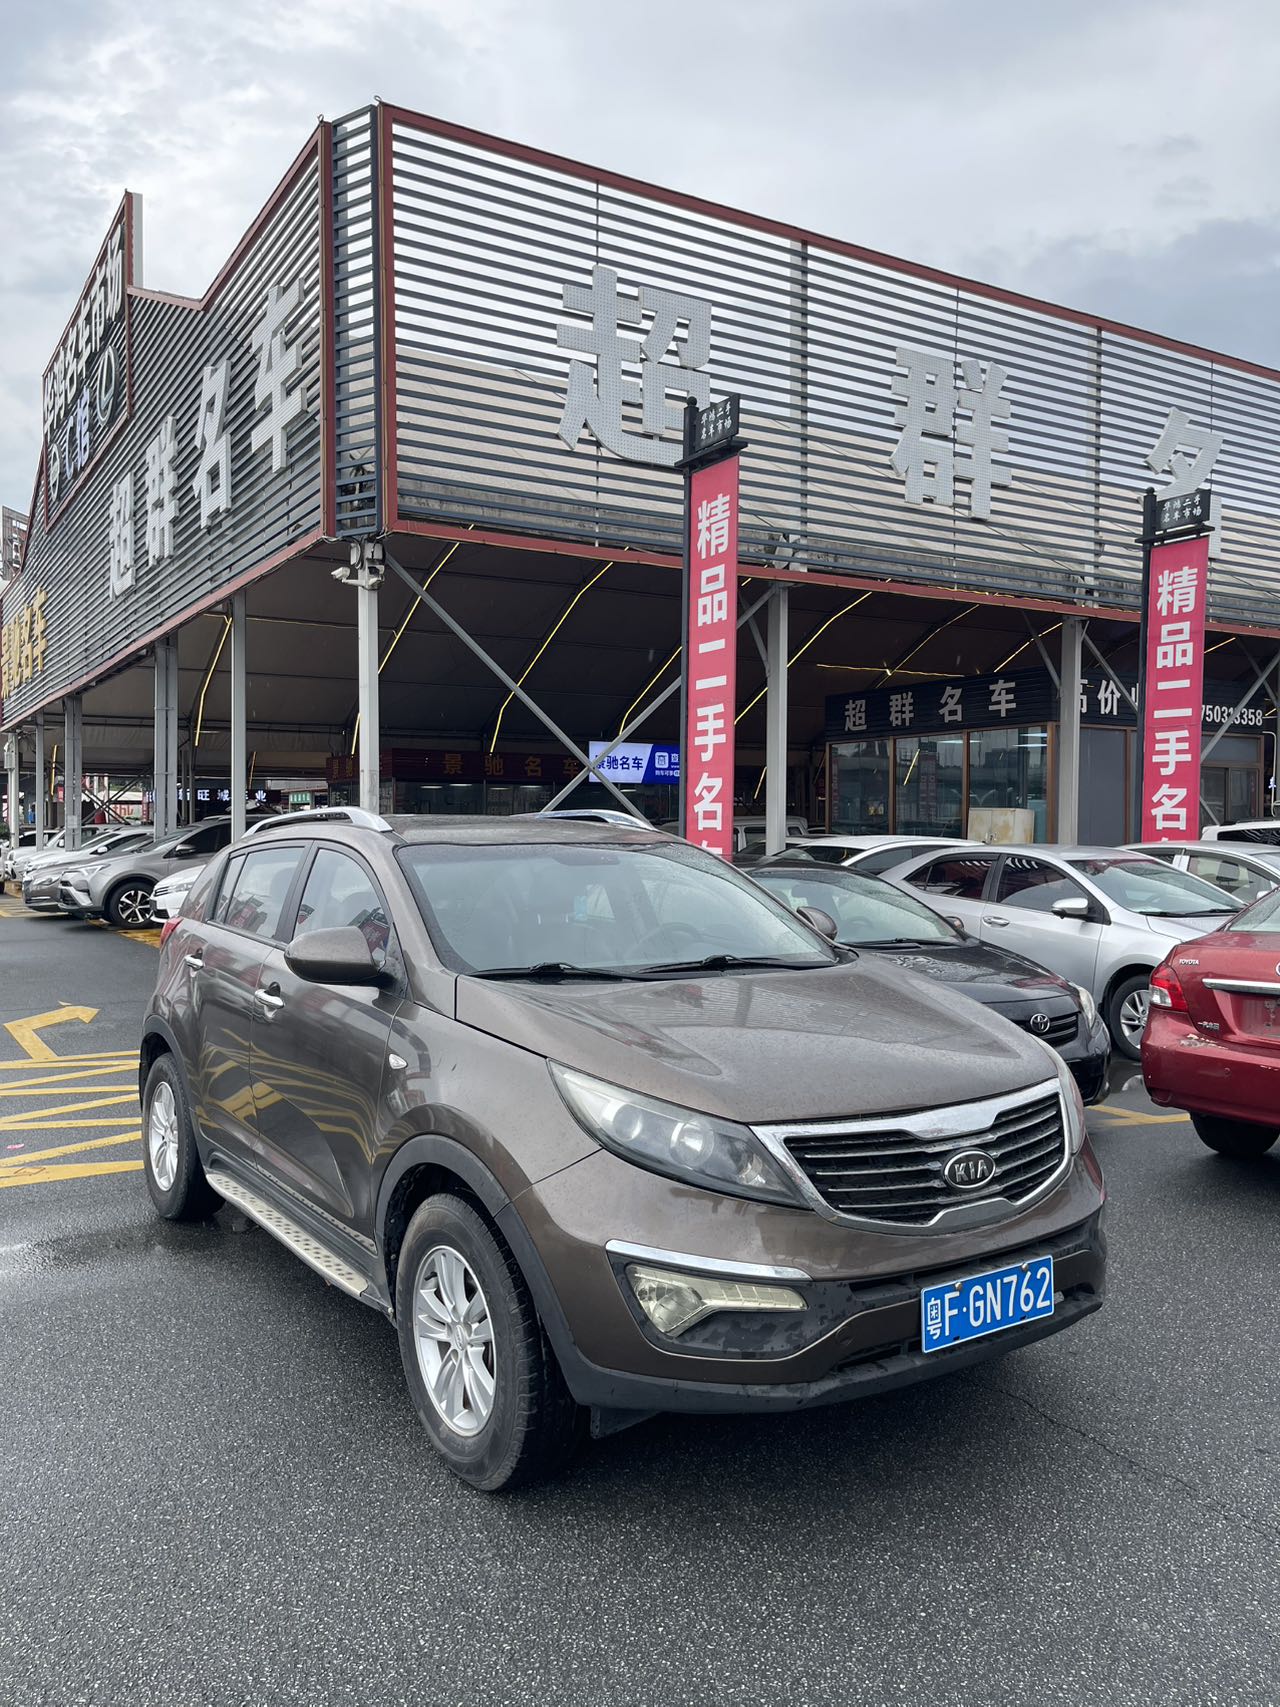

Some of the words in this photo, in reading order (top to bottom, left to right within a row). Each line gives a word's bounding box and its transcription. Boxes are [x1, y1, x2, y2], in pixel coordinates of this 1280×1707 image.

[43, 223, 122, 443] 华鸿名车市场
[701, 401, 731, 425] 华鸿二手
[109, 276, 307, 599] 超群名车
[701, 416, 732, 440] 名车市场
[1163, 494, 1200, 511] 华鸿二手
[1163, 506, 1202, 523] 名车市场
[693, 493, 731, 856] 精品二手名
[845, 679, 1017, 732] 超群名车
[1151, 566, 1198, 842] 精品二手名
[443, 753, 581, 779] 景驰名车
[1179, 958, 1199, 966] TOYOTA
[953, 1159, 990, 1183] KIA
[926, 1266, 1051, 1340] 粤F·GN762
